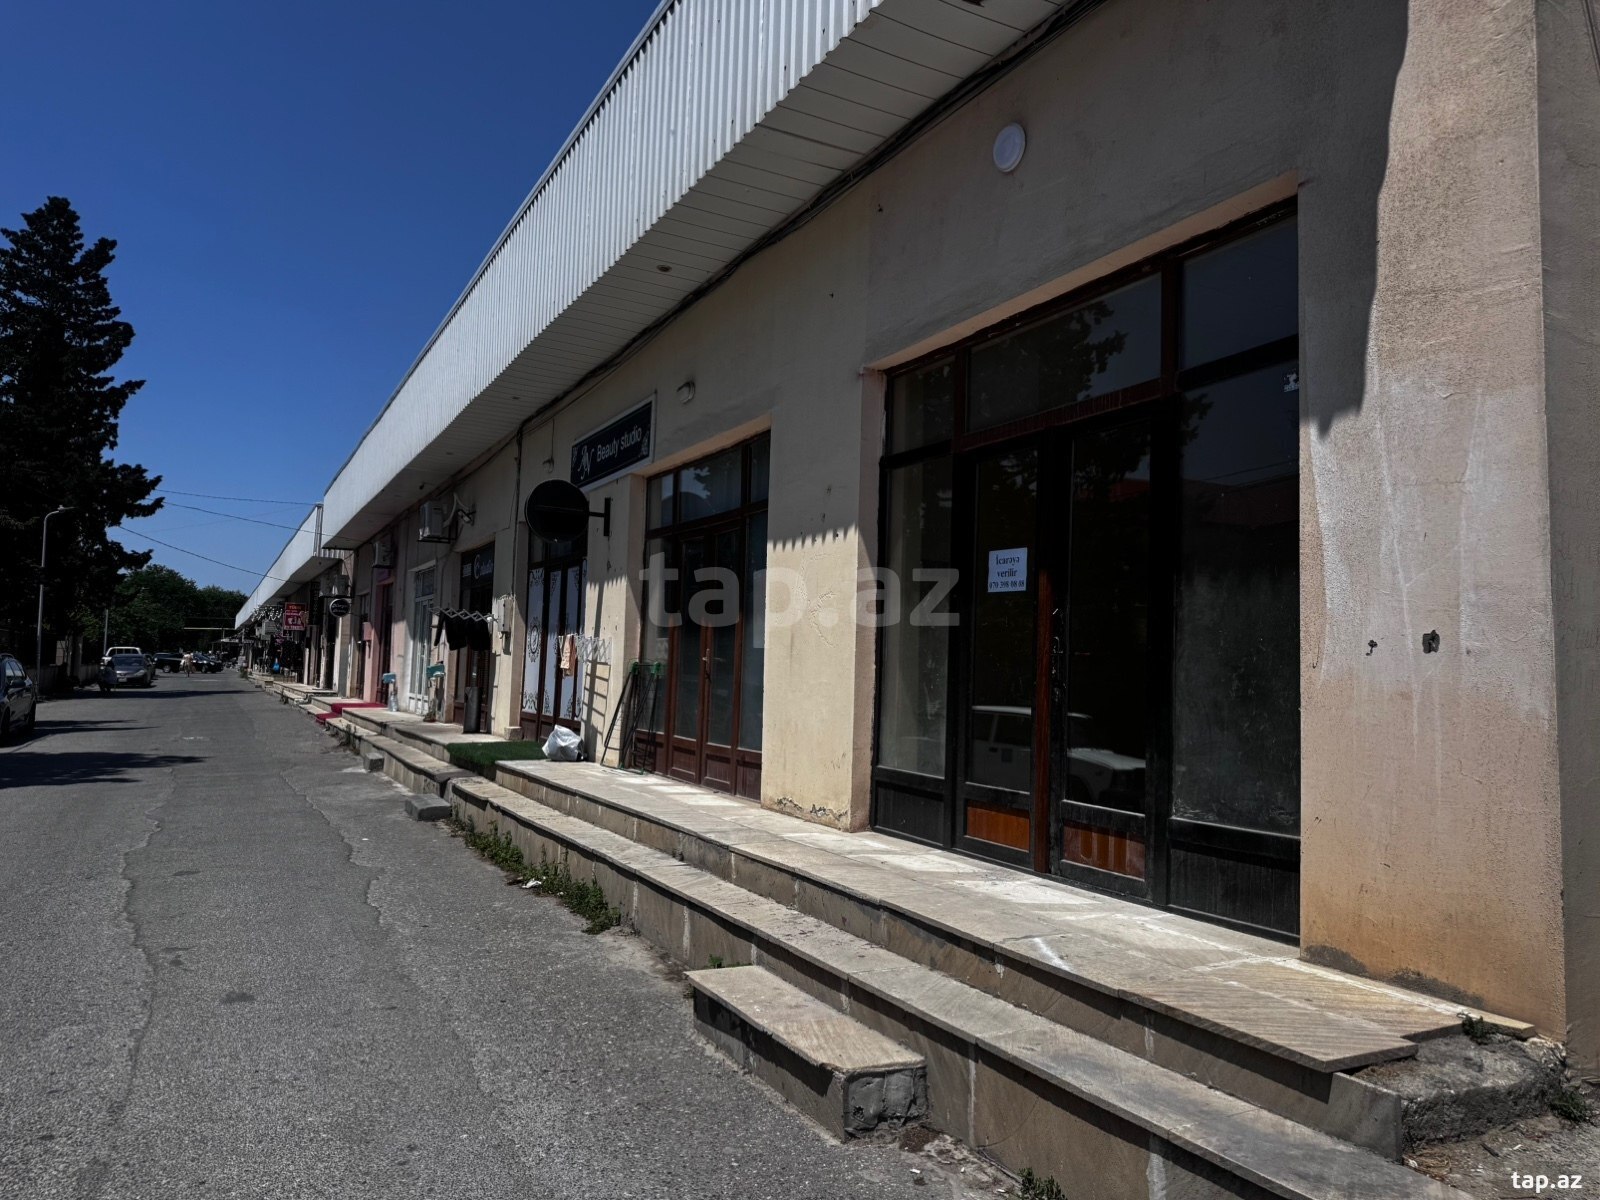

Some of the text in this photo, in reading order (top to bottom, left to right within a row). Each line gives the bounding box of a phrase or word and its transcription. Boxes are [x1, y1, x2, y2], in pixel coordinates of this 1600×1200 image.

[597, 437, 620, 463] Beauty
[620, 424, 642, 450] studio
[997, 568, 1018, 577] verilir
